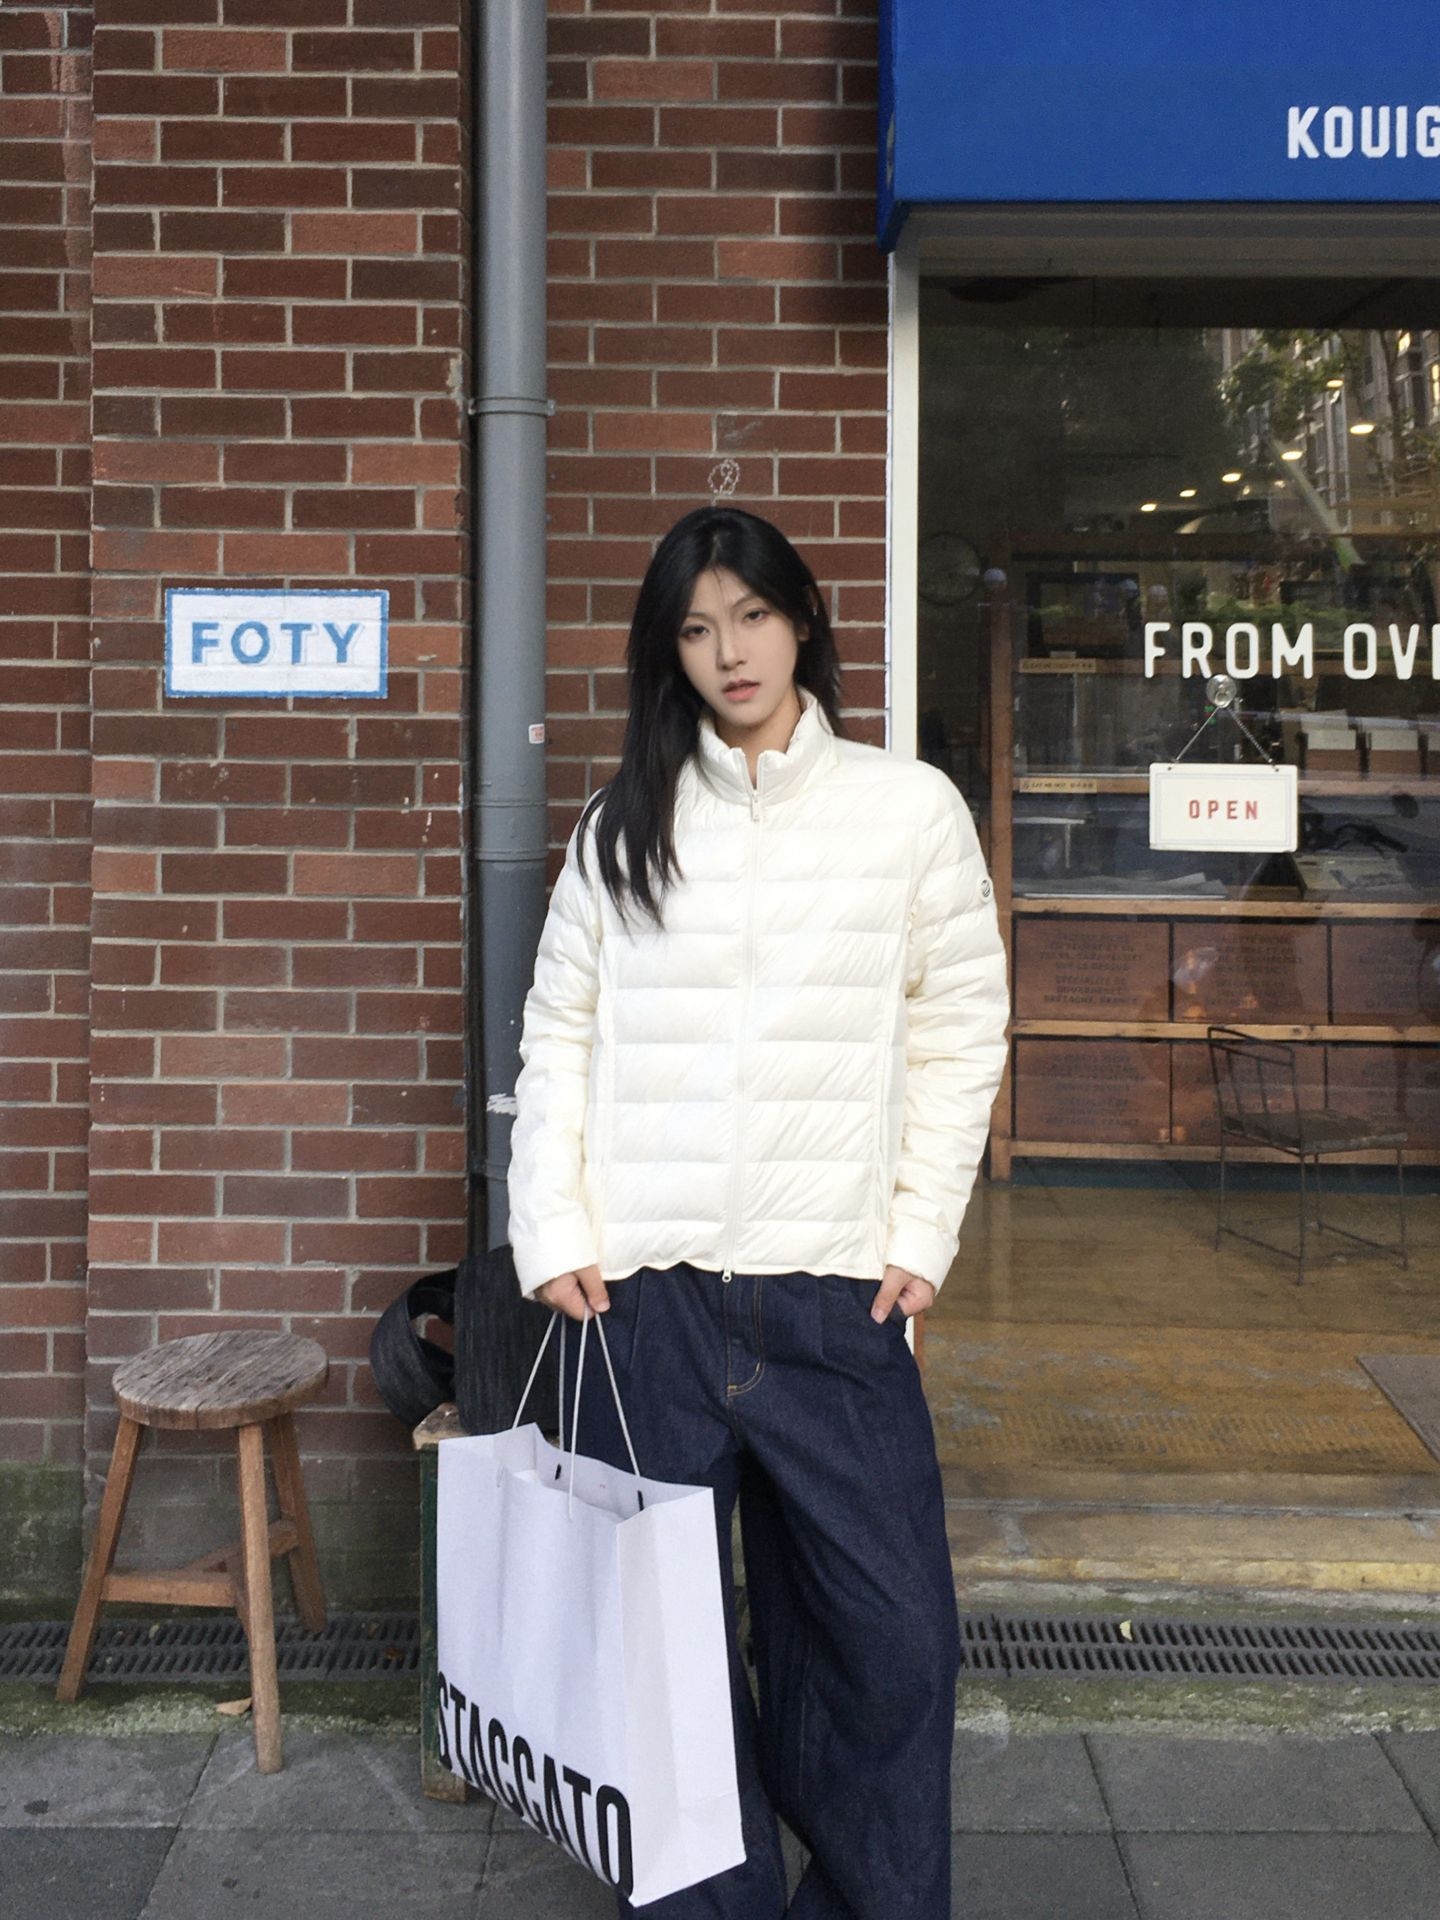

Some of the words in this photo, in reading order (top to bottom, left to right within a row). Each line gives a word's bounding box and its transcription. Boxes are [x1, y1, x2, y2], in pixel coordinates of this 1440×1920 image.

[1287, 105, 1440, 159] KOUIG
[191, 620, 360, 665] FOTY
[1144, 622, 1314, 680] FROM
[1343, 623, 1440, 681] OV
[1188, 799, 1259, 820] OPEN
[438, 1671, 634, 1898] STACCATO
